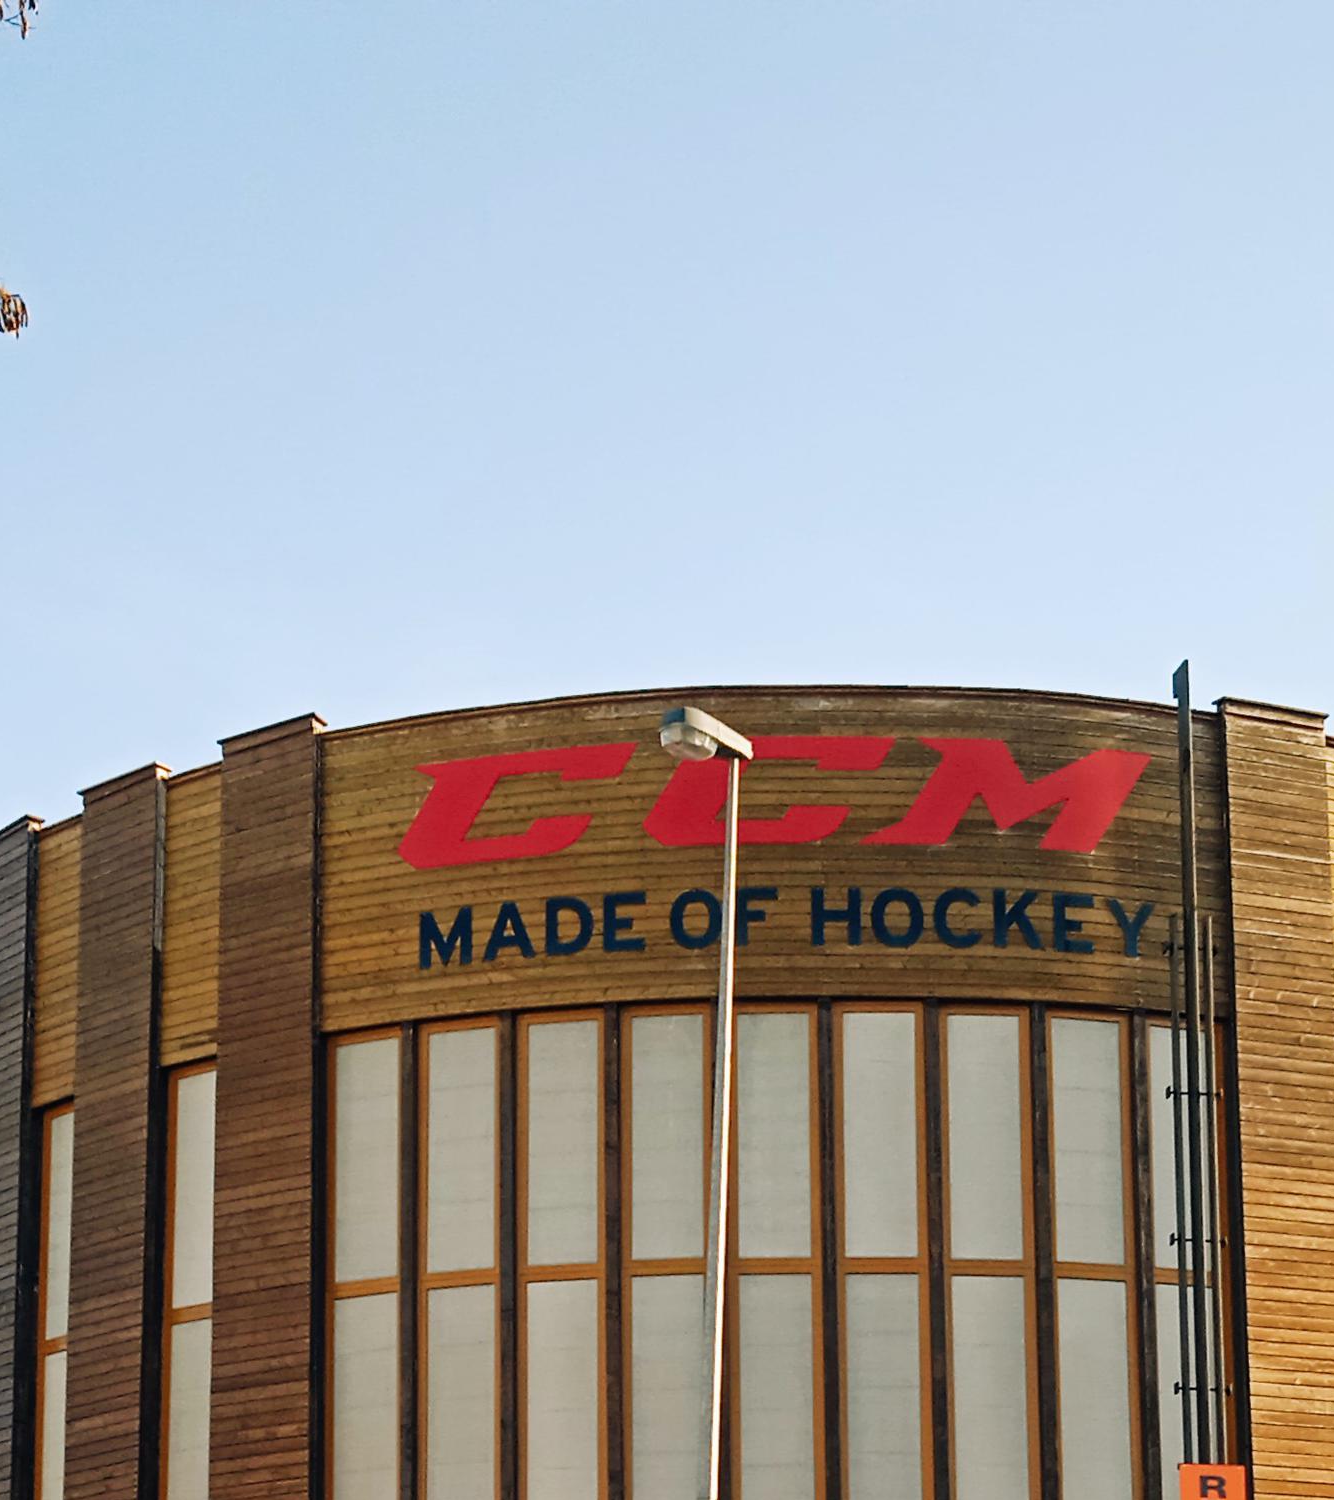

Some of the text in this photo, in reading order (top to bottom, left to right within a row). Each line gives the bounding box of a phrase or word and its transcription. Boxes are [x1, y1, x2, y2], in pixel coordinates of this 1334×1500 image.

[397, 736, 1152, 870] CCM
[417, 886, 1157, 970] MADE OF HOCKEY
